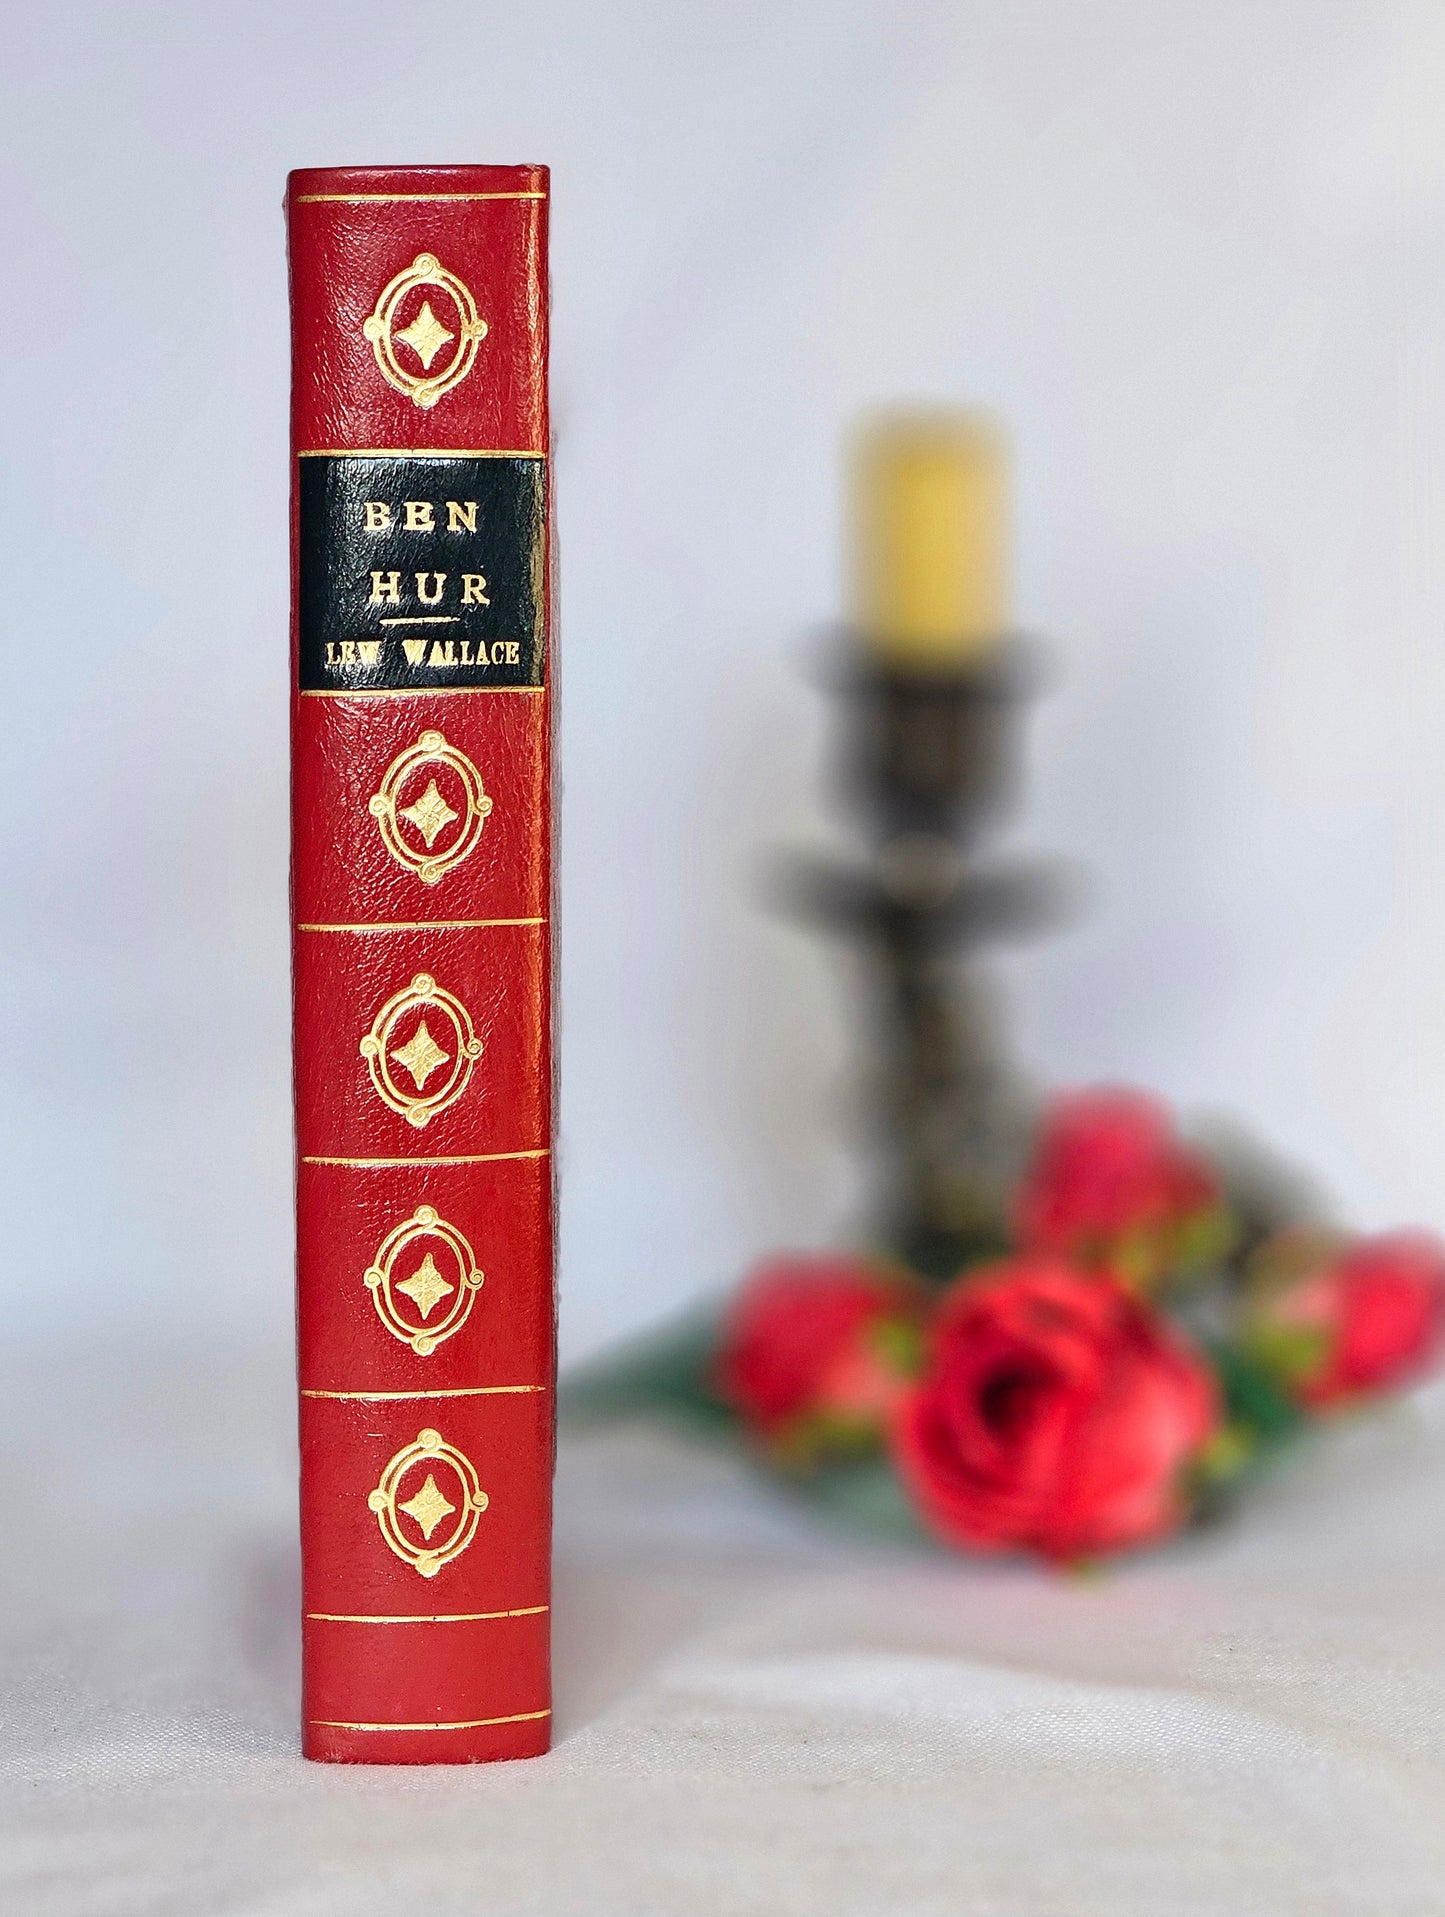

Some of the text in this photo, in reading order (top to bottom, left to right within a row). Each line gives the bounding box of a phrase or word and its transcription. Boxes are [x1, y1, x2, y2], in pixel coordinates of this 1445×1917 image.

[363, 501, 479, 532] BEN
[368, 571, 491, 605] HUR
[326, 639, 520, 666] LEW WALLACE
